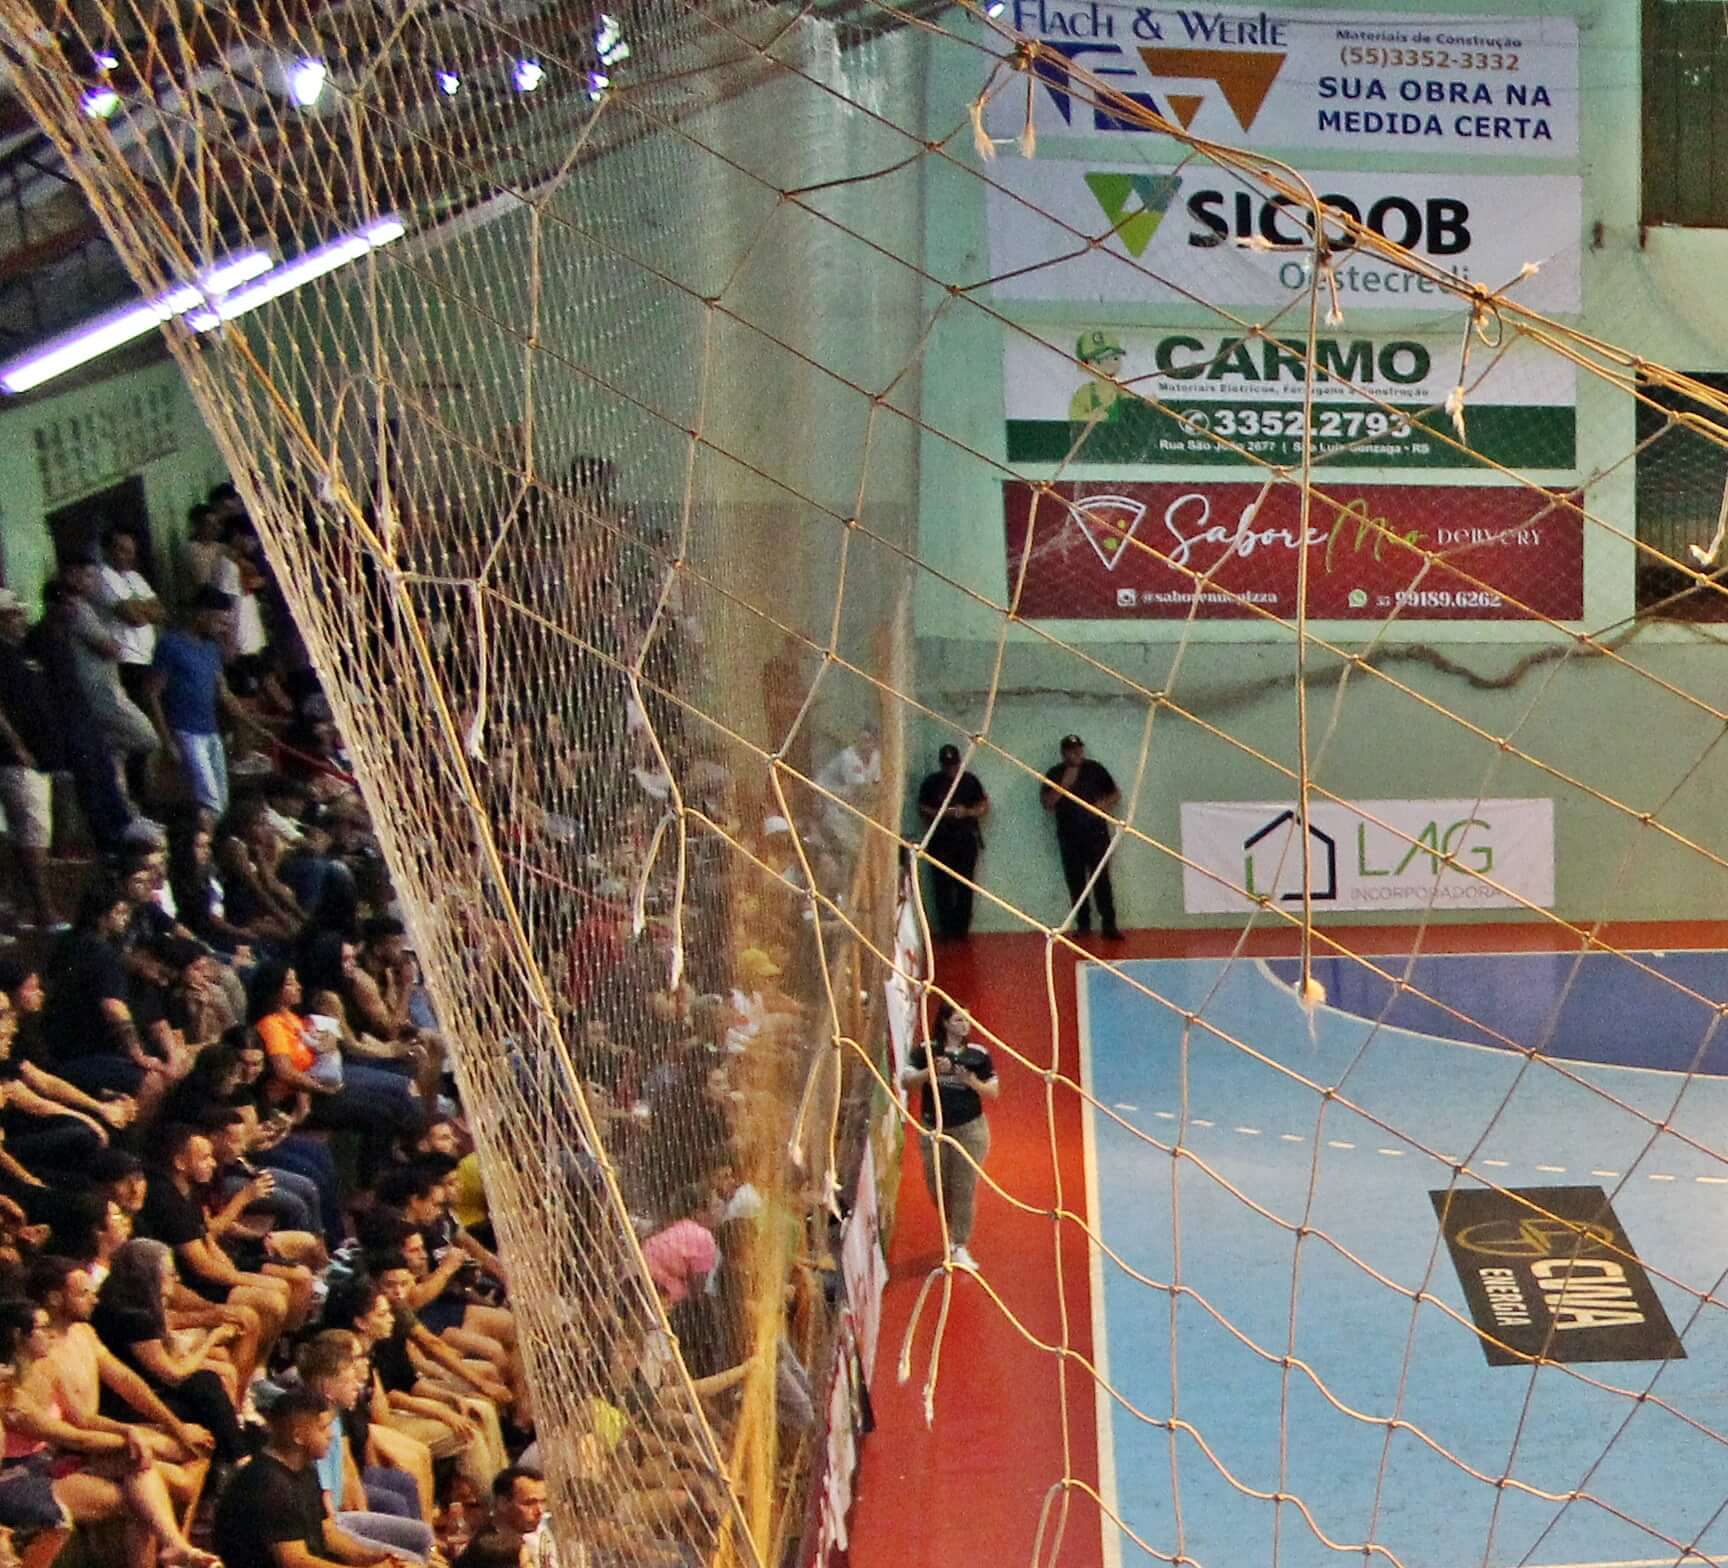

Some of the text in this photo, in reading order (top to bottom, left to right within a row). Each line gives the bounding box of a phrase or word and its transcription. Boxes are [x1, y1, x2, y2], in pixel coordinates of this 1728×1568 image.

[1132, 8, 1164, 40] &
[1336, 29, 1523, 48] Materiais de Construção
[1340, 45, 1520, 71] (55)3352-3332
[1318, 76, 1552, 106] SUA OBRA NA
[1317, 110, 1553, 140] MEDIDA CERTA
[1187, 190, 1471, 254] SICOOB
[1155, 335, 1432, 384] CARMO
[1159, 439, 1185, 450] Rua
[1164, 493, 1329, 569] Sabore
[1358, 818, 1493, 876] LAG
[1479, 1267, 1533, 1327] ENERGIA
